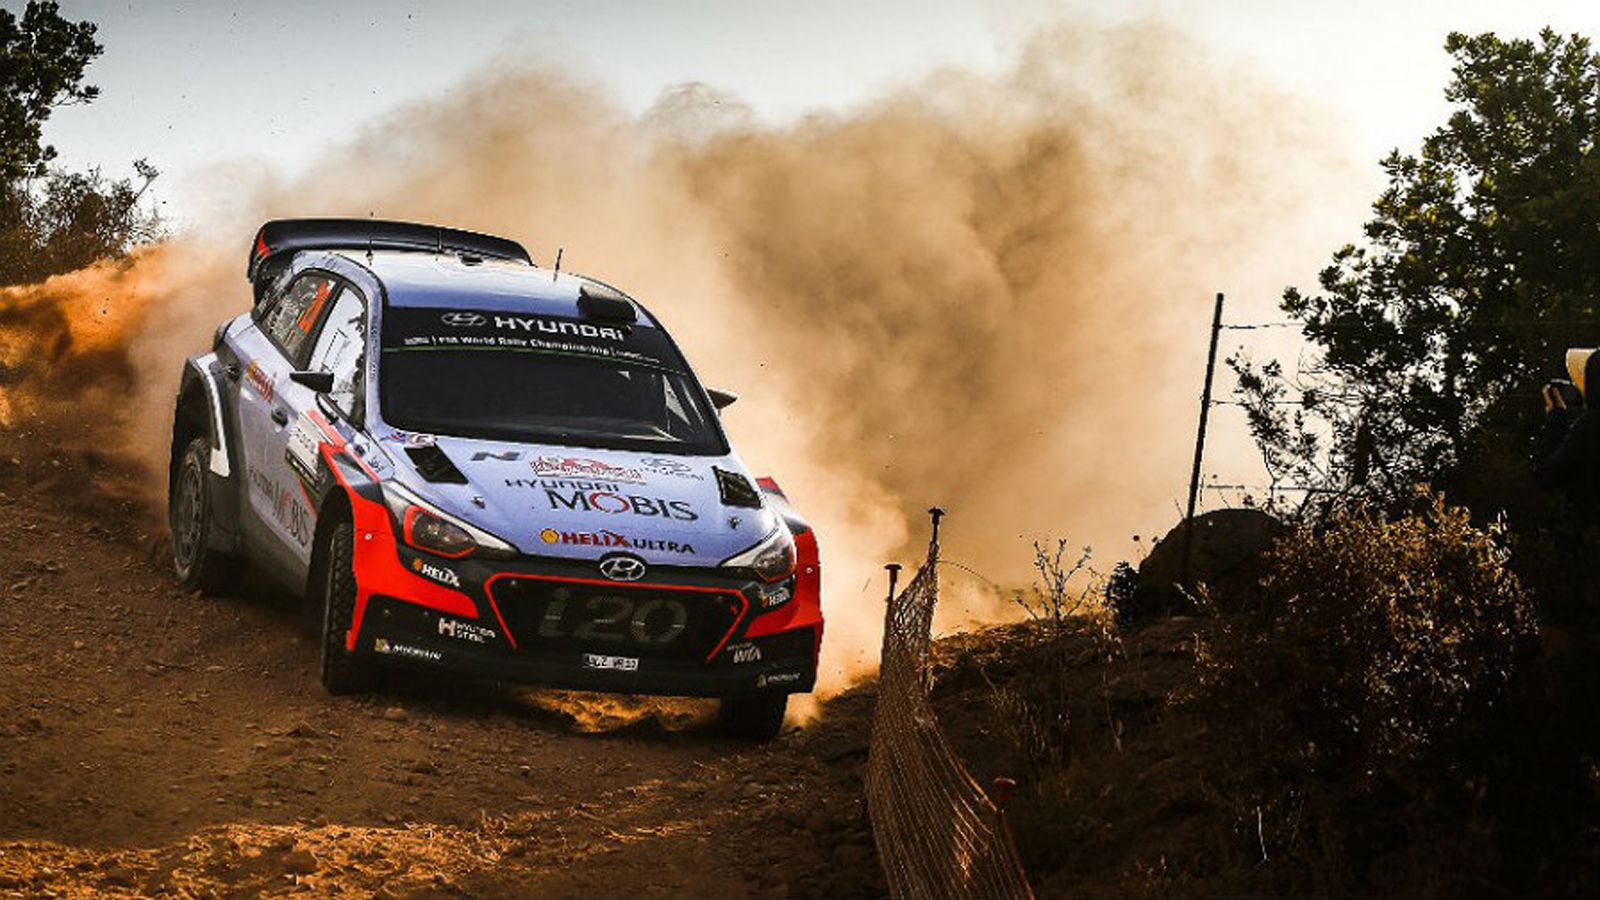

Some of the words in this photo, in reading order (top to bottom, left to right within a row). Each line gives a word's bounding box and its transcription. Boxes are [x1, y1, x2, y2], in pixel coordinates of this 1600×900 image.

[494, 315, 624, 341] HYUNDAI
[504, 478, 620, 492] HYUNDAI
[544, 490, 699, 521] MOBIS
[562, 530, 629, 549] HELIX
[631, 538, 696, 554] ULTRA
[421, 563, 461, 588] HELIX
